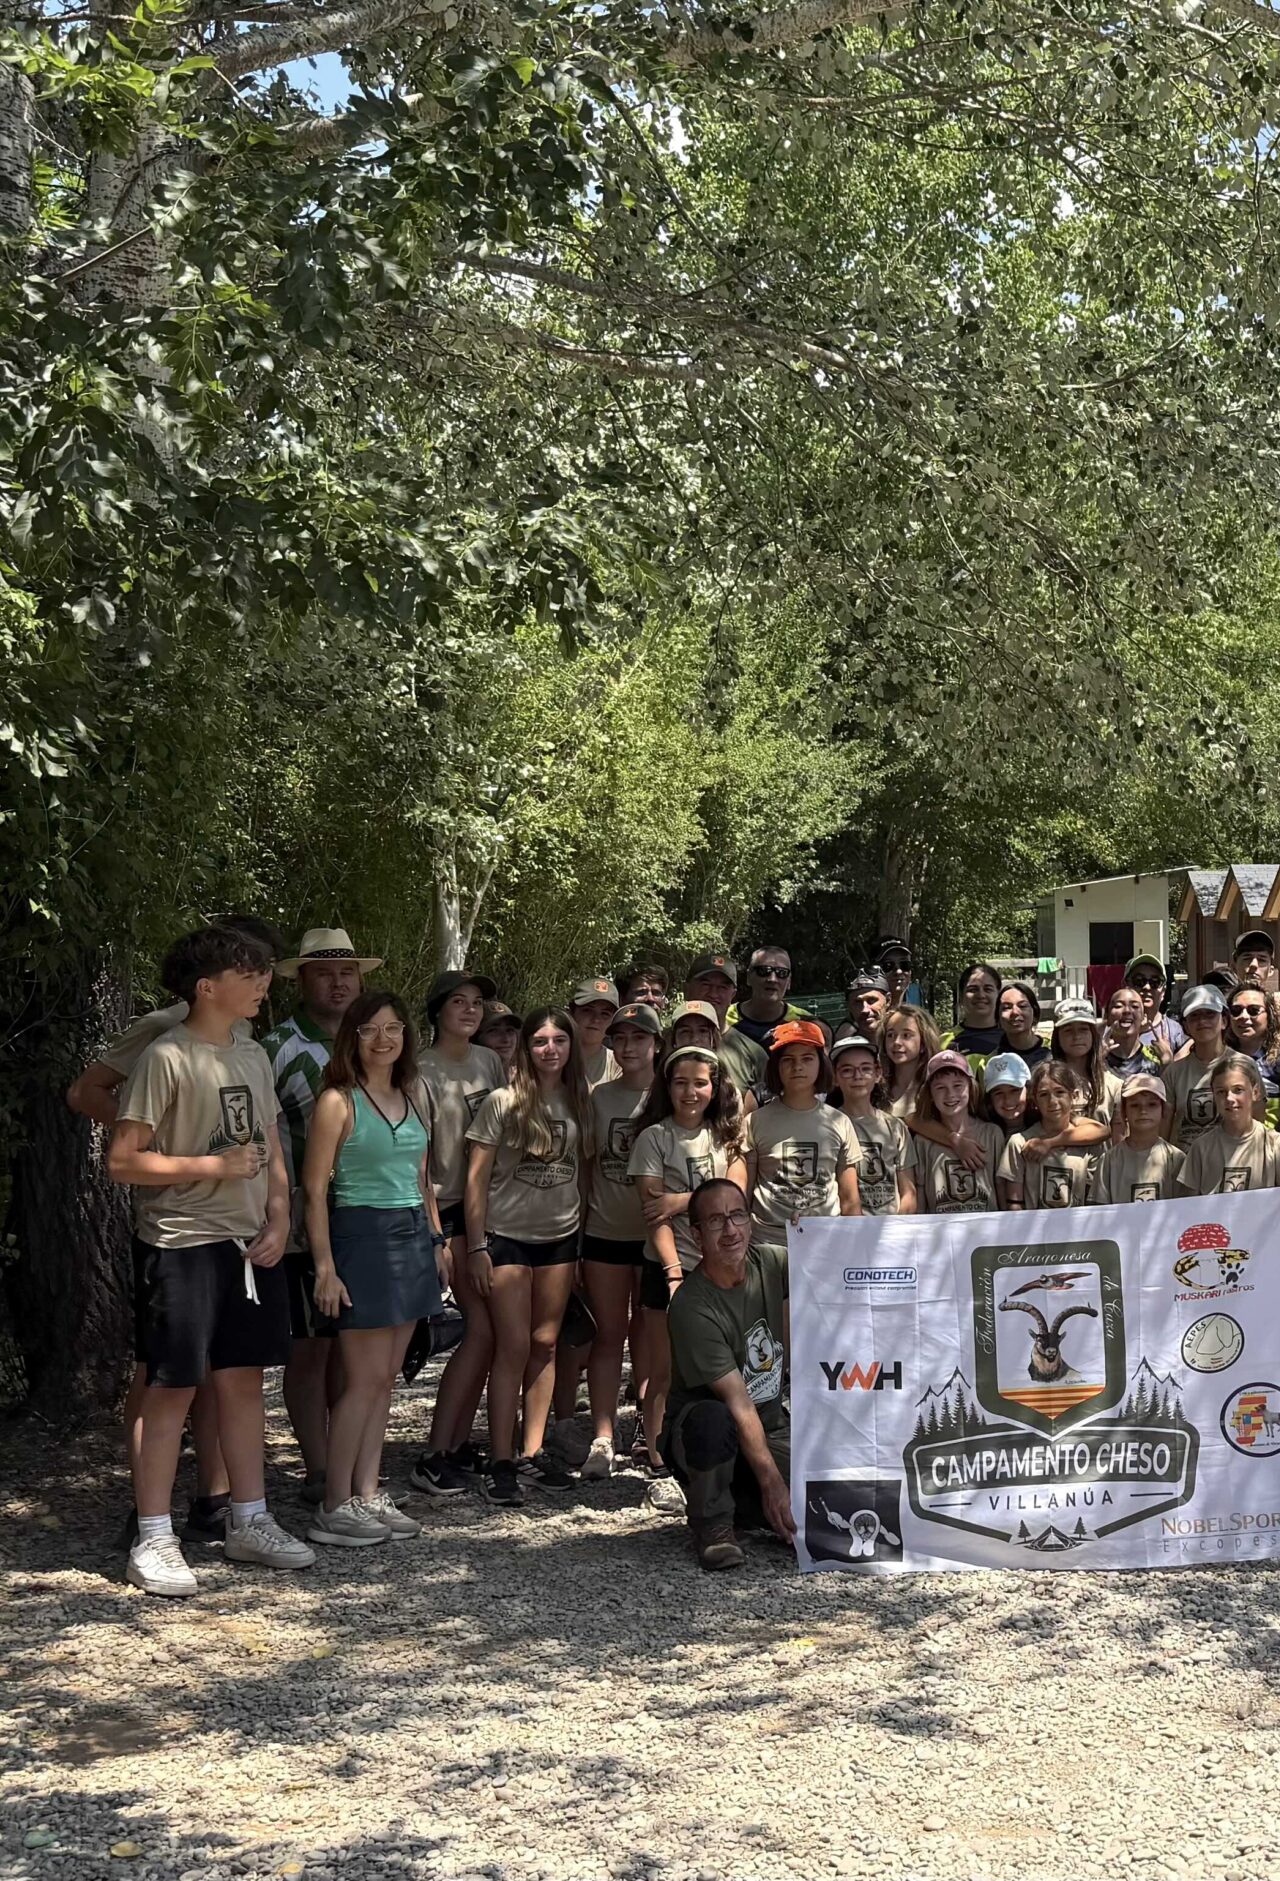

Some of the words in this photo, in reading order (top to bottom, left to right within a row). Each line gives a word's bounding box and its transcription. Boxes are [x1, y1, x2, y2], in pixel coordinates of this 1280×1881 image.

[997, 1246, 1092, 1265] Aragonesa
[846, 1270, 914, 1281] CONOTECH
[1174, 1289, 1222, 1302] MUSKARI
[1184, 1320, 1207, 1349] AEPES
[819, 1361, 903, 1391] YWH
[932, 1443, 1091, 1488] CAMPAMENTO
[1095, 1442, 1171, 1476] CHESO
[988, 1487, 1114, 1510] VILLANÚA
